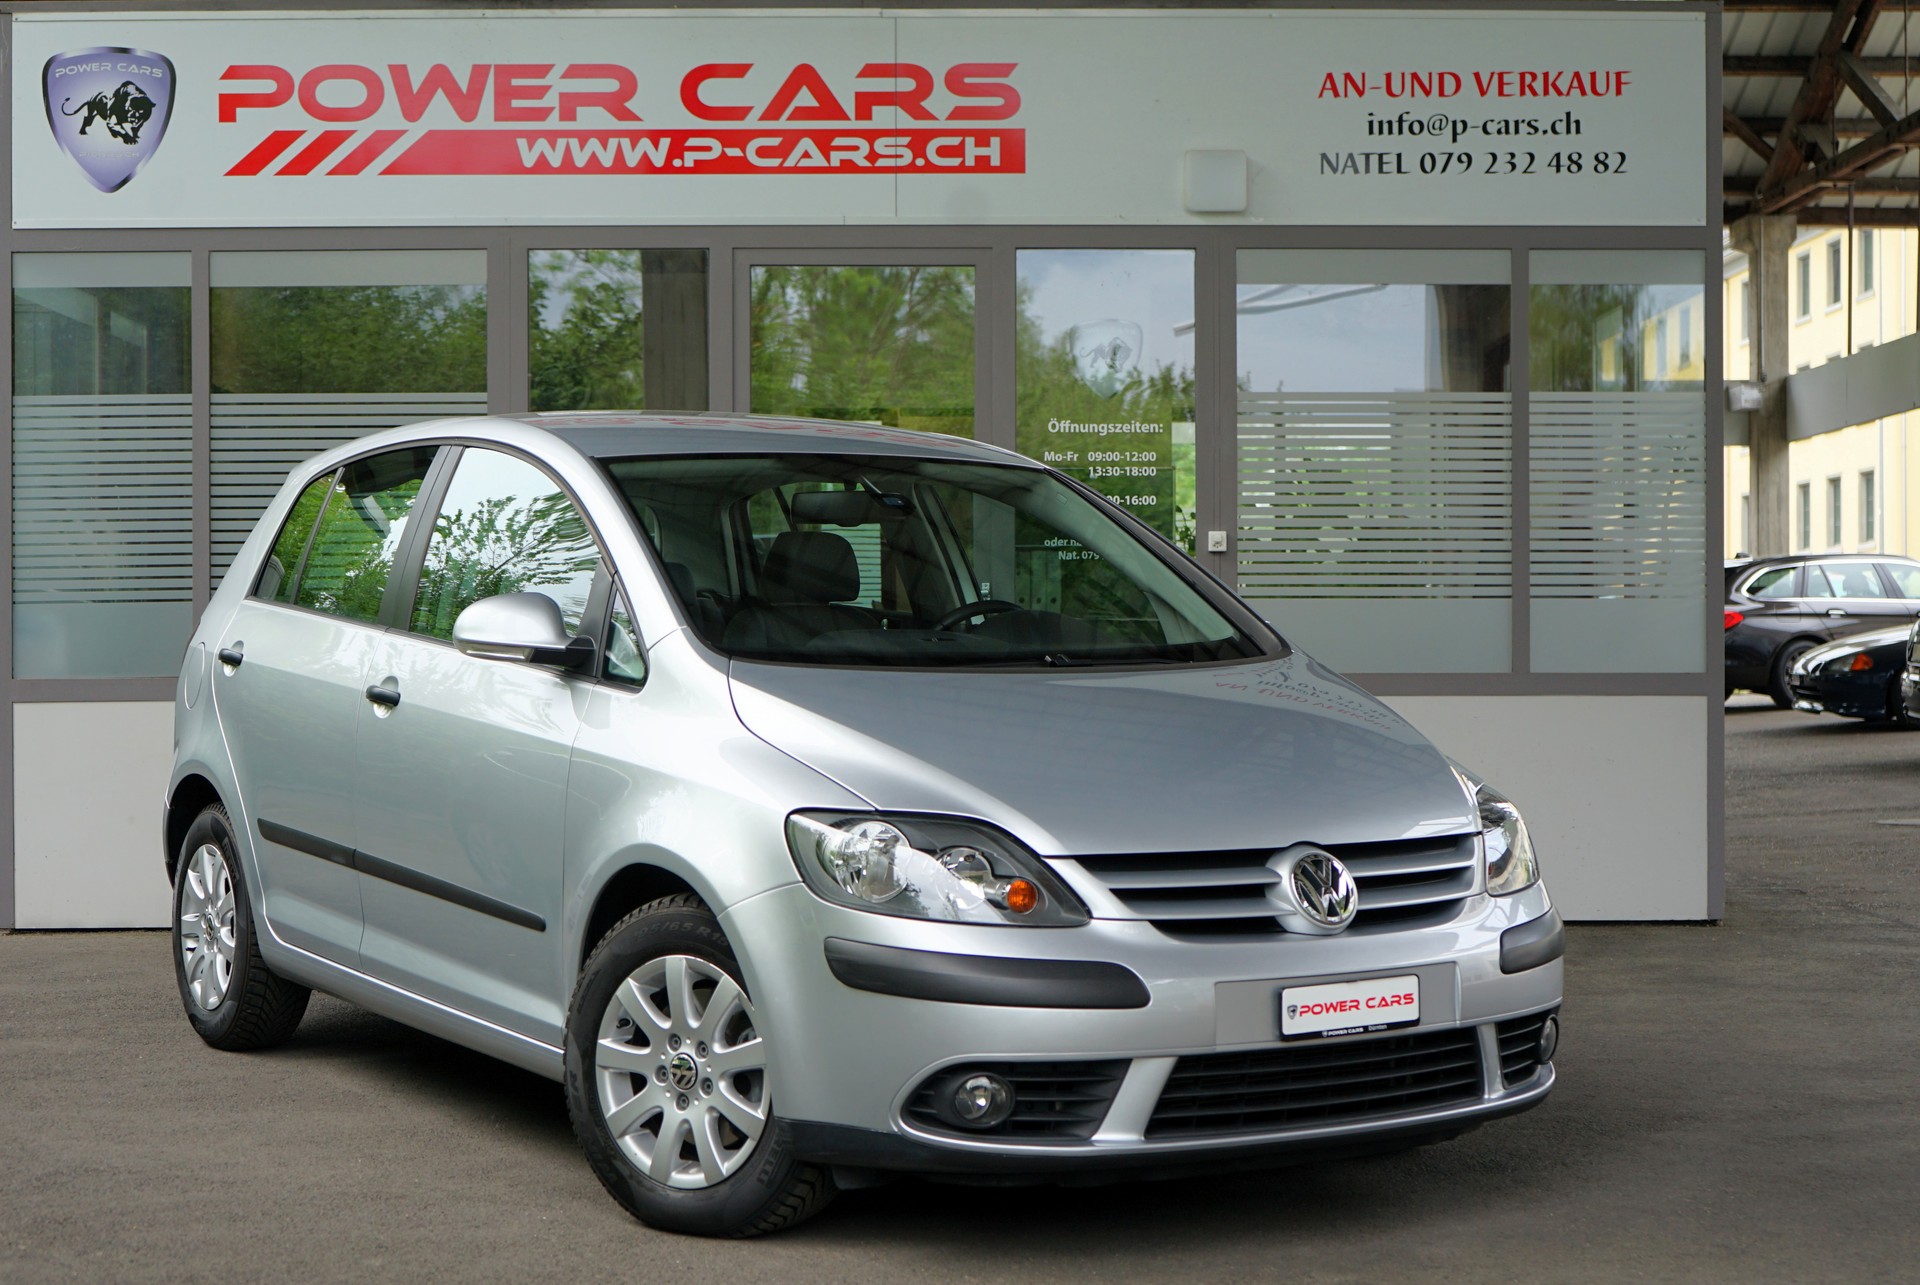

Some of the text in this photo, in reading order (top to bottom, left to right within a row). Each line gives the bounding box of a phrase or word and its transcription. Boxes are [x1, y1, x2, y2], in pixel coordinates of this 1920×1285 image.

[55, 62, 163, 78] POWER CARS
[218, 62, 1022, 123] POWER CARS
[1318, 70, 1633, 99] AN-UND VERKAUF
[1367, 111, 1582, 144] info@p-cars.ch
[516, 136, 1001, 169] WWW.P-CARS.CH
[1320, 152, 1629, 175] NATEL 079 232 48 82
[1047, 418, 1163, 435] Öffnungszeiten:
[1044, 451, 1157, 462] Mo-Fr 09:00-12:00
[1088, 466, 1157, 477] 13:30-18:00
[1044, 536, 1069, 547] oder
[1058, 550, 1080, 560] Nat.
[1299, 992, 1415, 1017] POWER CARS
